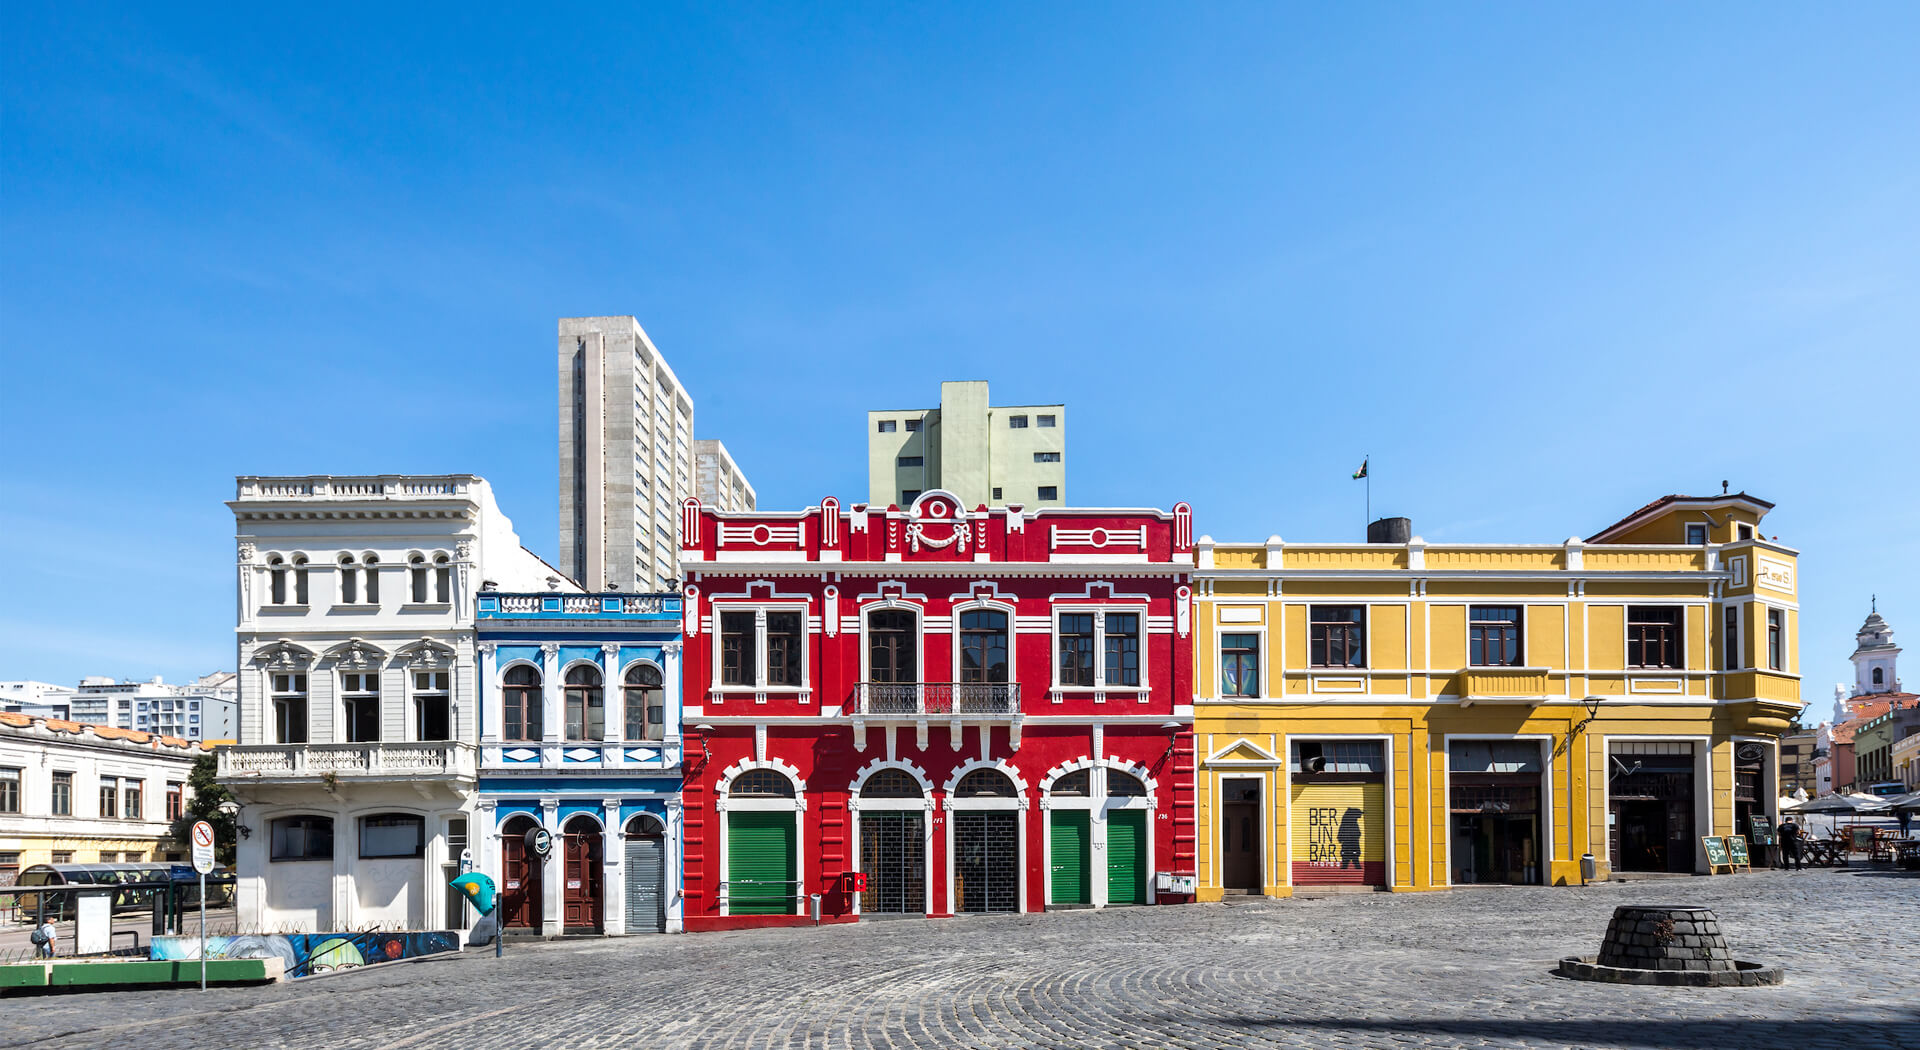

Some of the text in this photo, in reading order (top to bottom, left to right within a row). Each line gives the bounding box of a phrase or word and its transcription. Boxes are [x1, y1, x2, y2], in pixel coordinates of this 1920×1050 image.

[1310, 808, 1338, 826] BER
[1310, 826, 1333, 844] LIN
[1310, 844, 1338, 861] BAR
